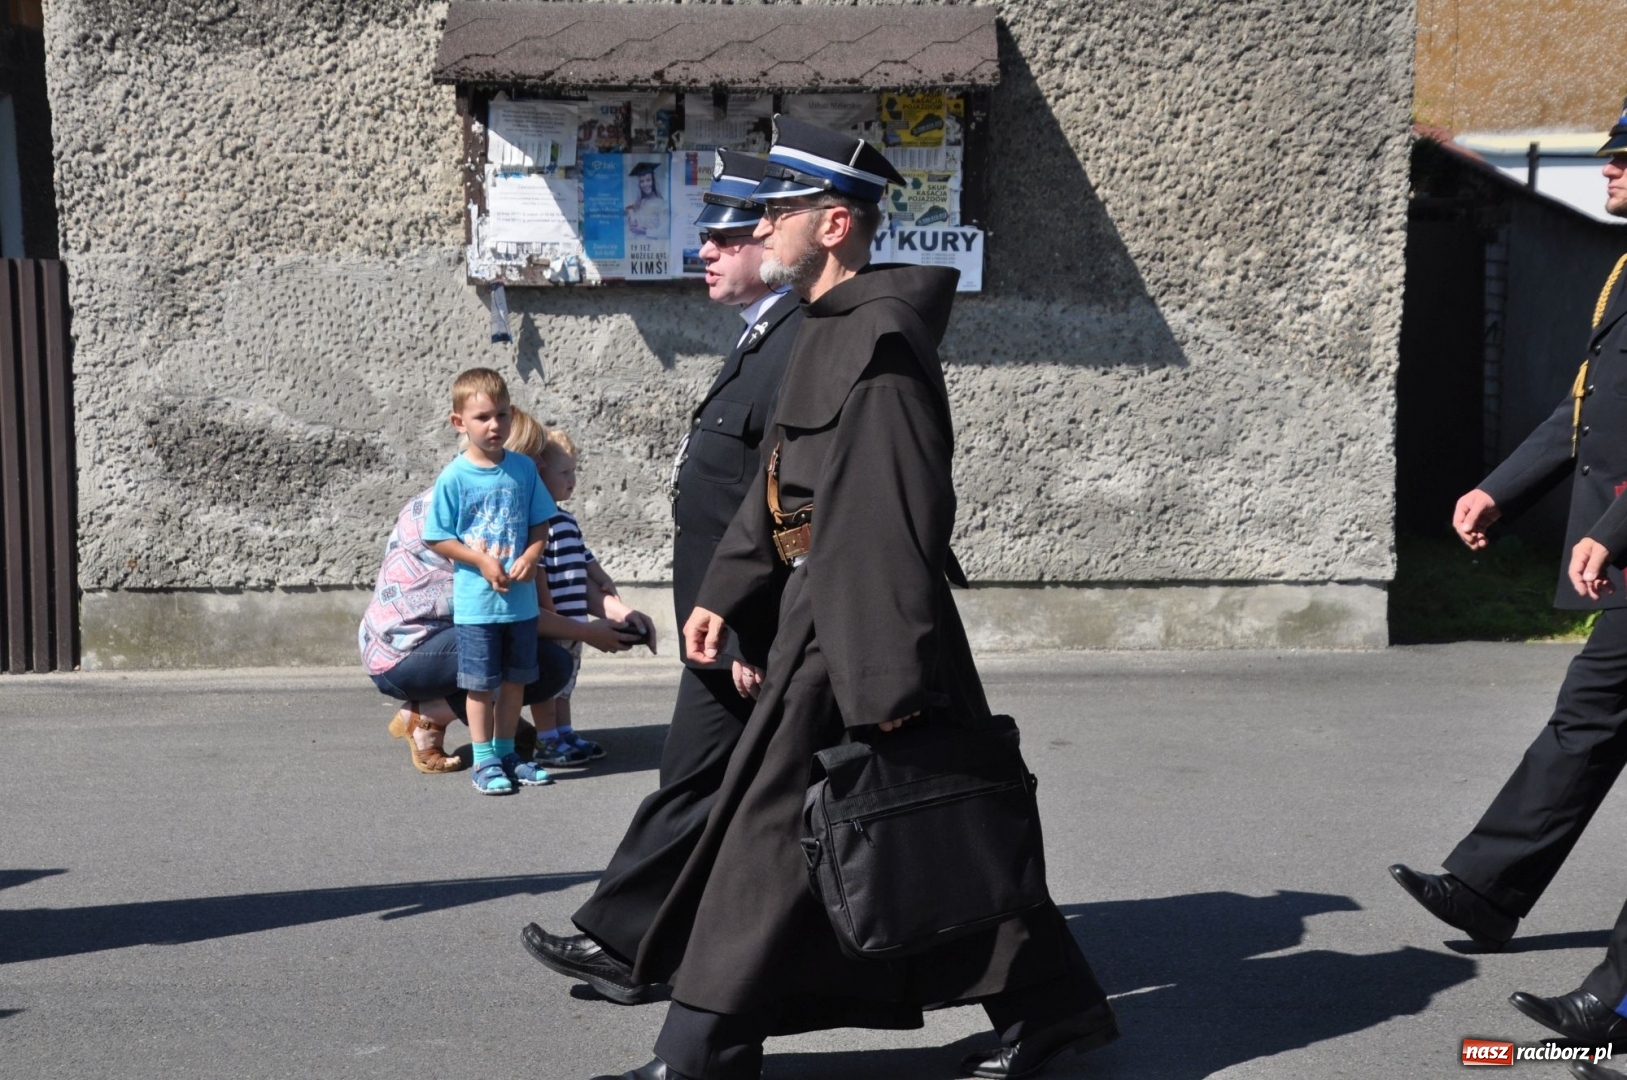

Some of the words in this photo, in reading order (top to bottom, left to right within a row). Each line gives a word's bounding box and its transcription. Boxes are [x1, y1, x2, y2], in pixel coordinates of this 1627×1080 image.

[908, 195, 948, 203] POJAZDÓW
[898, 230, 979, 252] KURY
[631, 258, 668, 275] KIMŚ!
